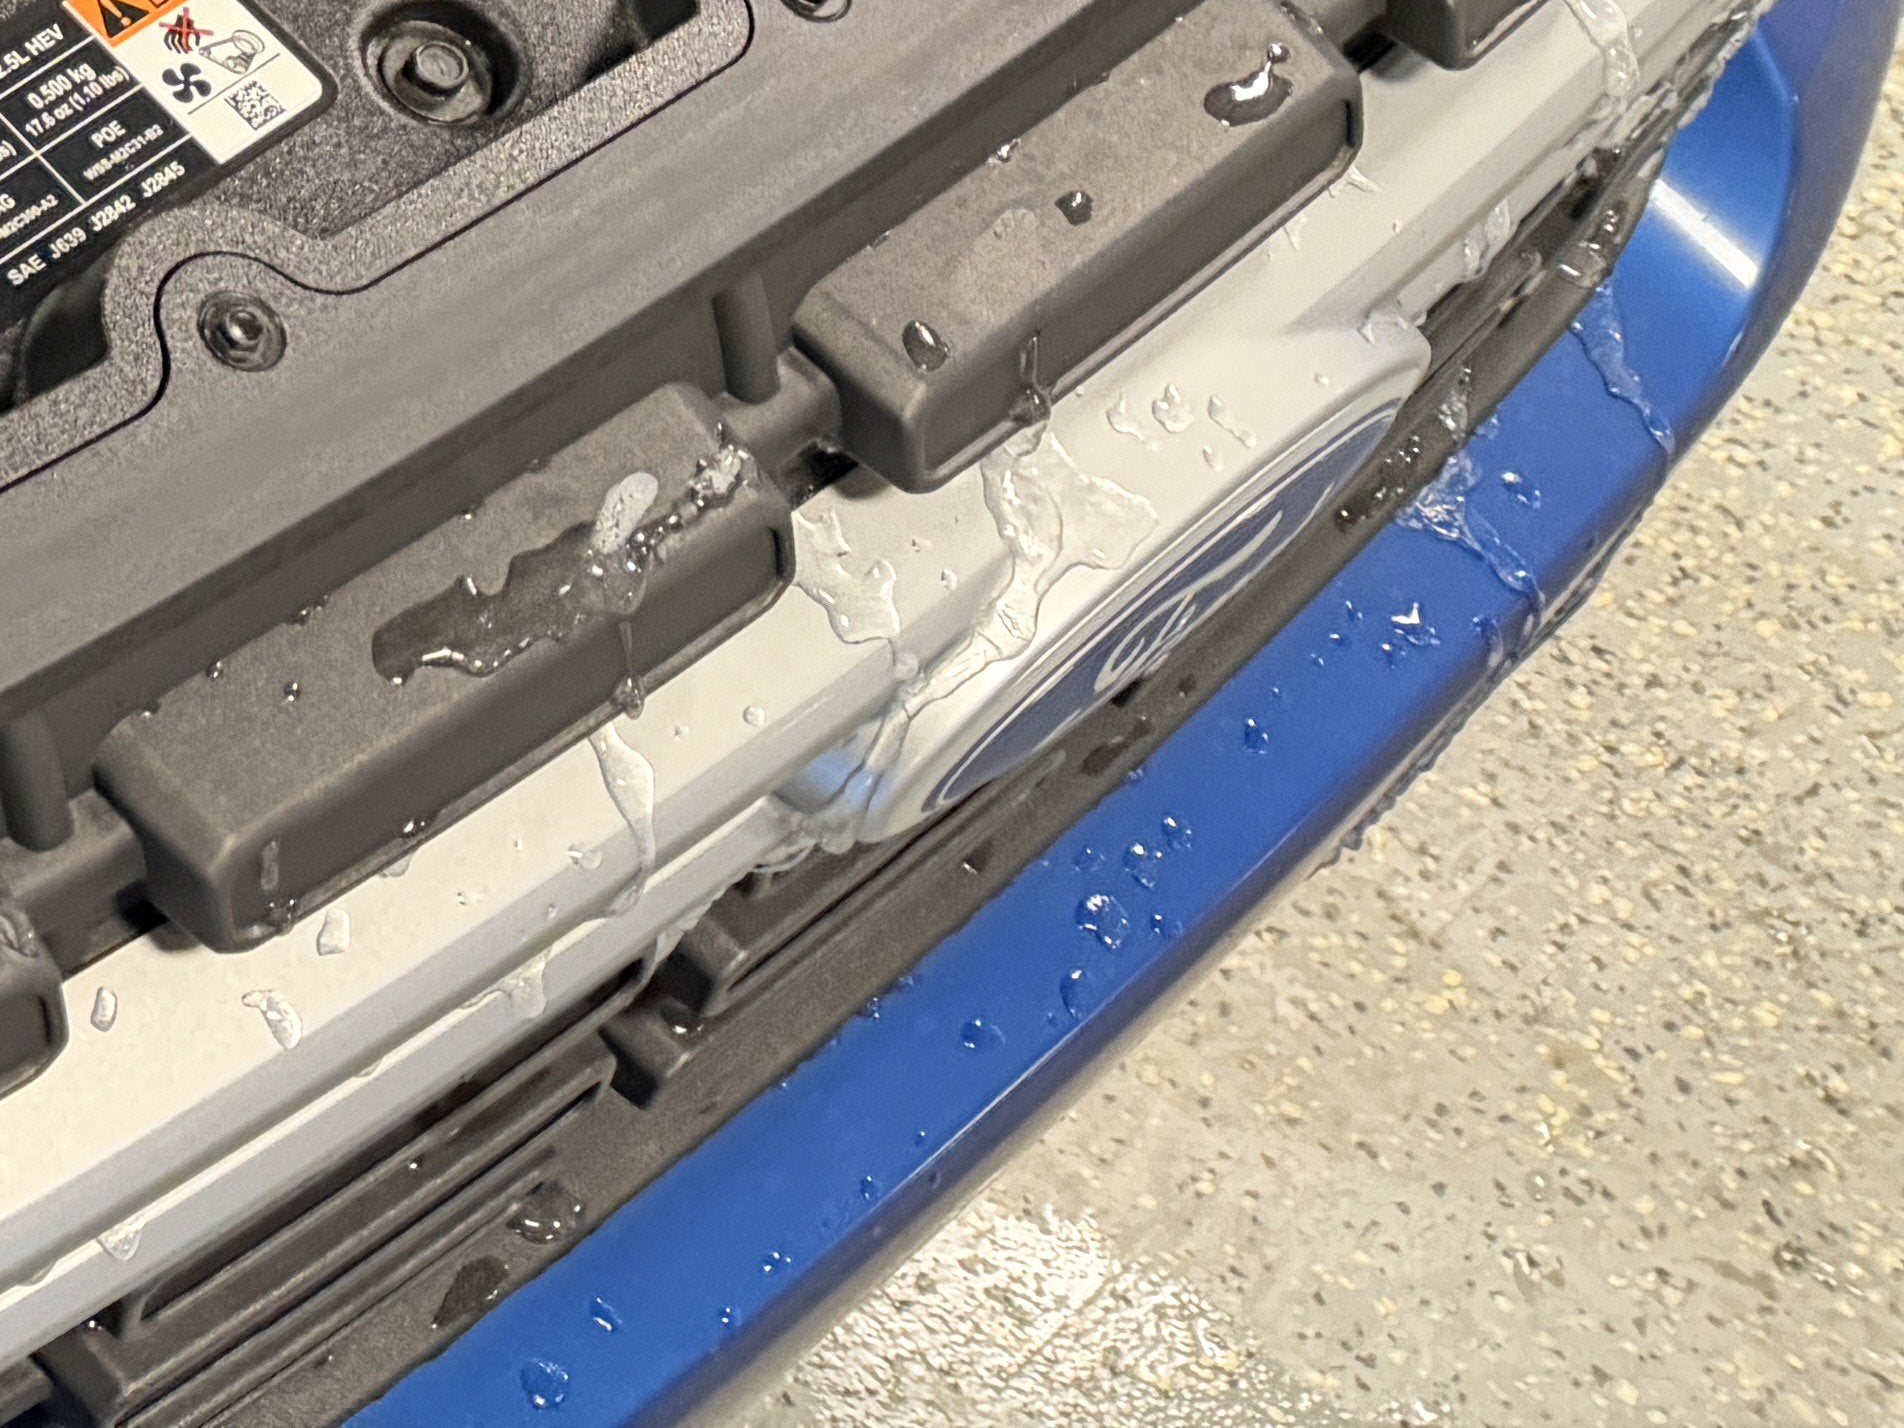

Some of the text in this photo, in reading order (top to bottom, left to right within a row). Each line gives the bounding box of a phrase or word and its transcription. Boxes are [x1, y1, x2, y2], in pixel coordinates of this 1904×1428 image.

[23, 23, 65, 57] HEV
[25, 65, 132, 138] 17.6 oz (1.10 lbs)
[26, 62, 97, 110] 0.500 kg
[90, 120, 127, 150] POE
[7, 161, 187, 287] SAE J639 J2842 J2845
